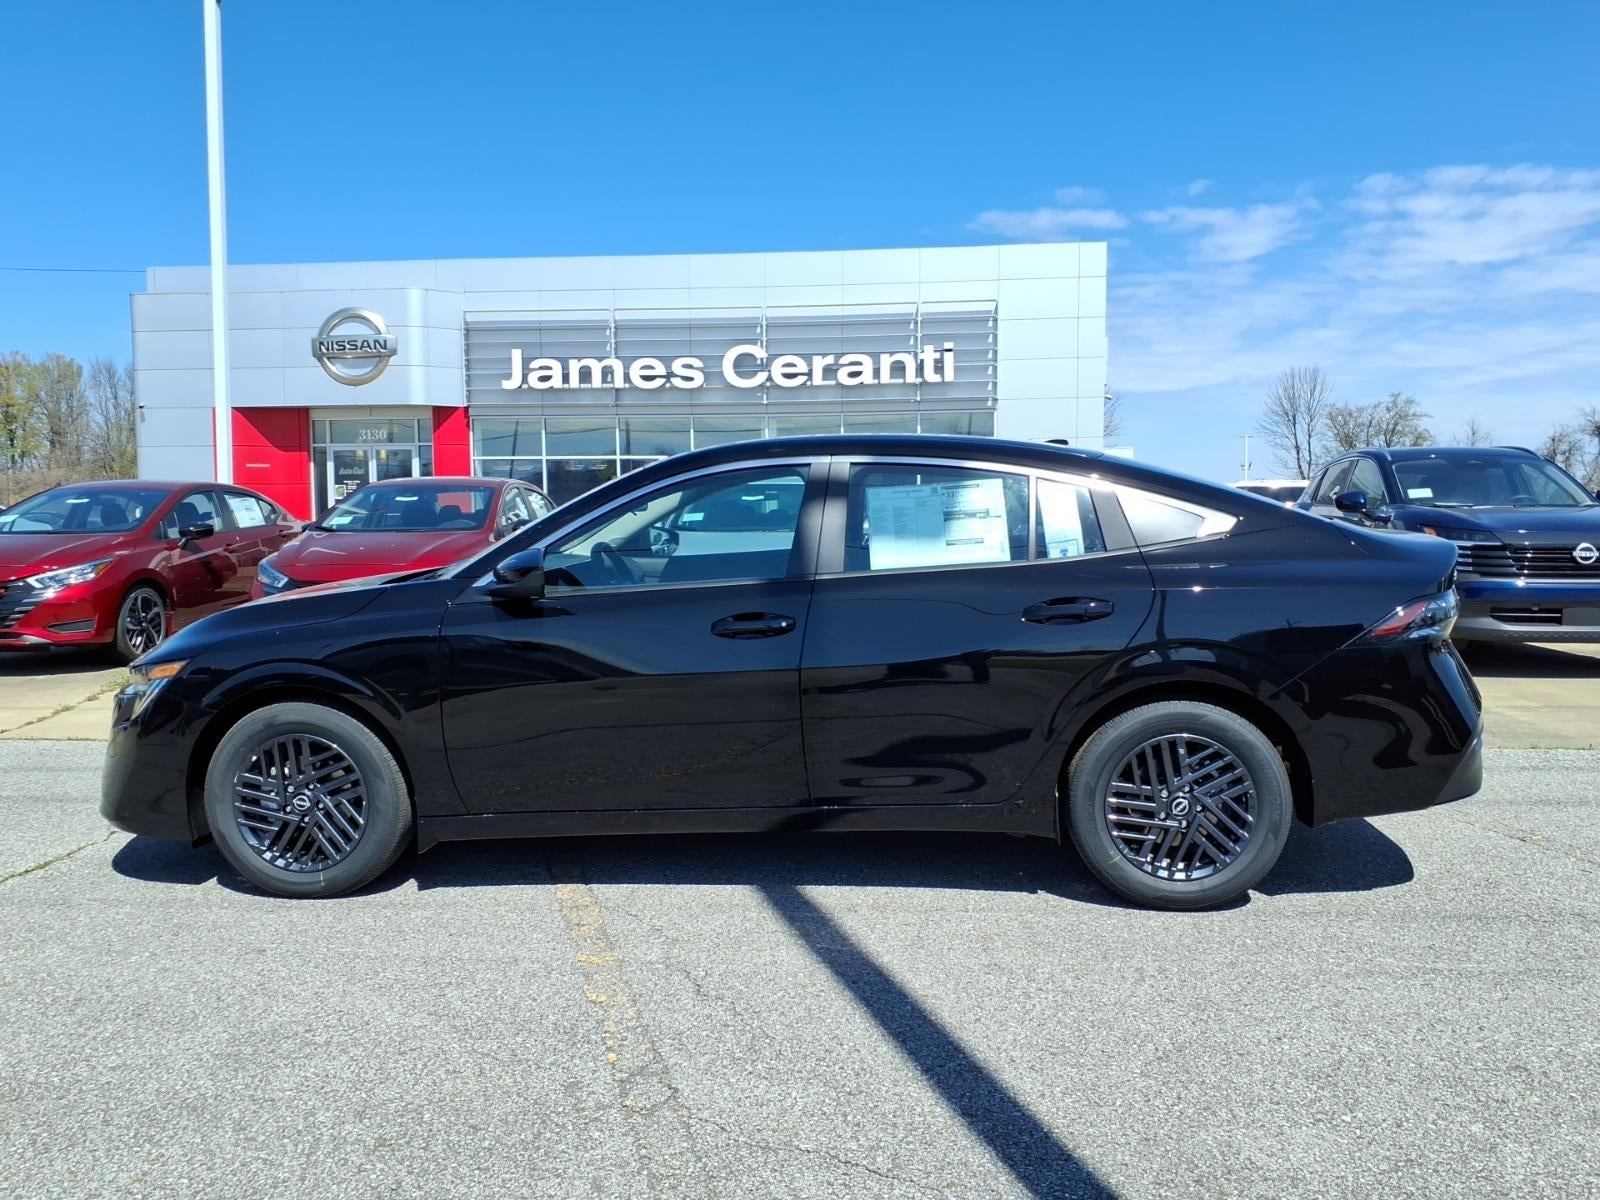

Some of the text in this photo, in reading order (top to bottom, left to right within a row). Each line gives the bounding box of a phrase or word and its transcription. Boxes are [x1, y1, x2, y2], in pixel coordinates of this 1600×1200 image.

[318, 339, 388, 353] NISSAN
[501, 342, 955, 390] James Ceranti
[359, 429, 387, 440] 3130
